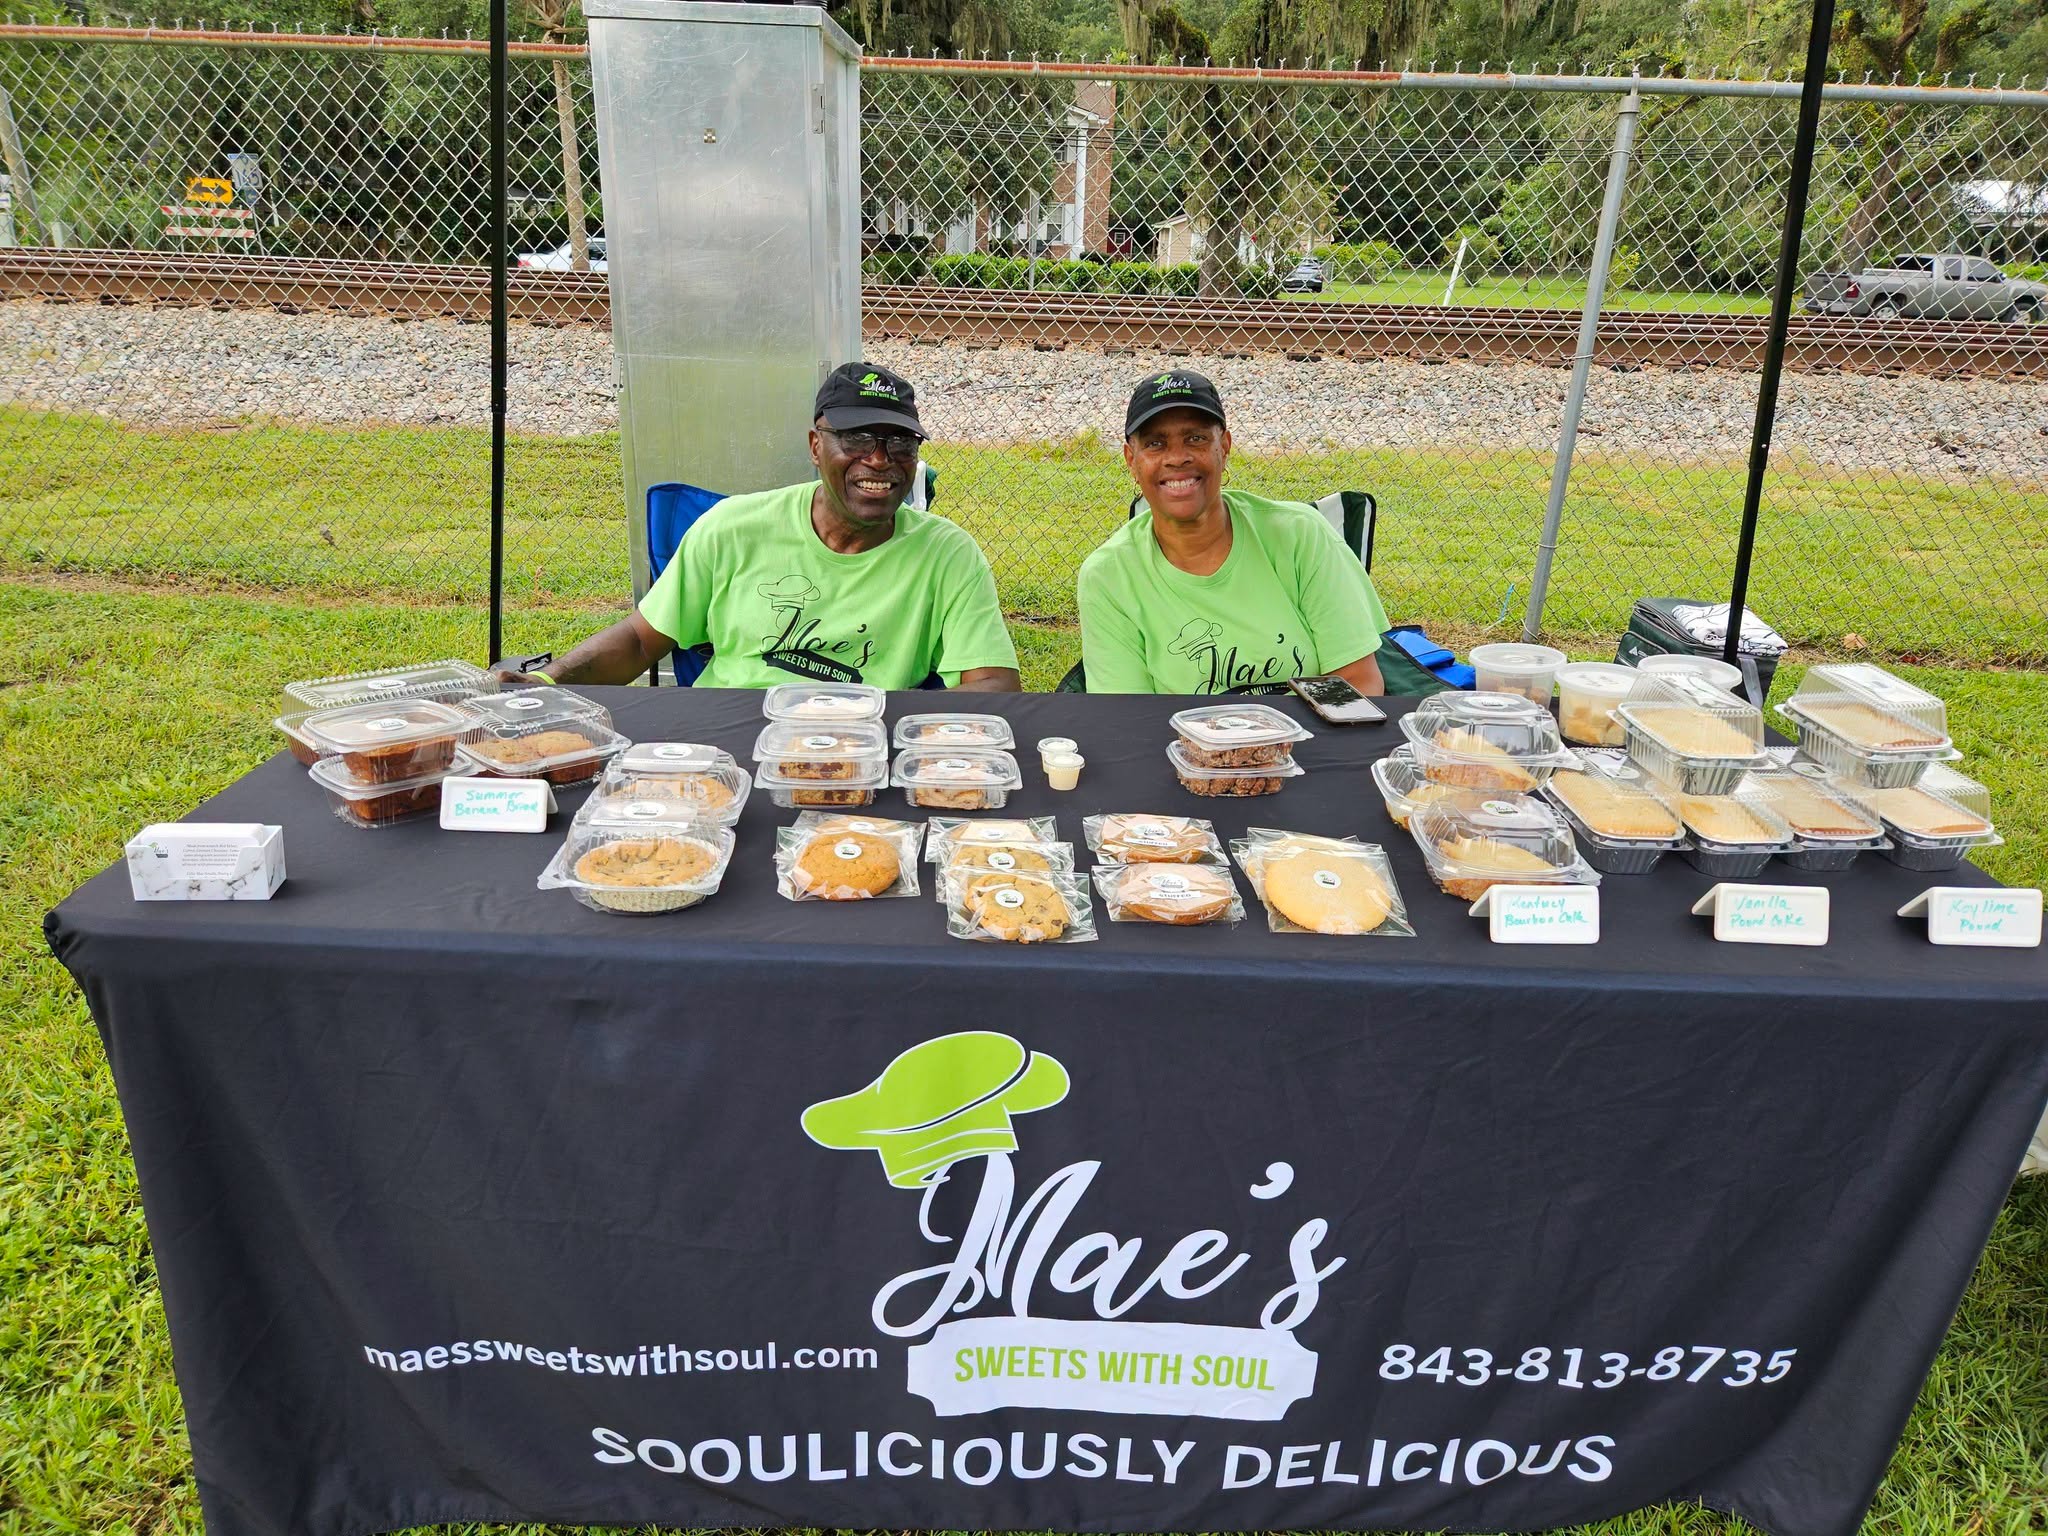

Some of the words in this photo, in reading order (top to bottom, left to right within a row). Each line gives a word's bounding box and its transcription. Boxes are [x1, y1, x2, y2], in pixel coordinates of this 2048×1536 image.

[760, 607, 876, 669] Mae's
[772, 652, 808, 670] SWEETS
[808, 660, 832, 677] WITH
[831, 668, 853, 685] SOUL
[1195, 633, 1306, 695] Mae's
[466, 789, 523, 801] Summer
[1730, 913, 1766, 928] Pound
[1732, 895, 1792, 911] Vanilla
[871, 1153, 1347, 1338] Mae's
[363, 1335, 879, 1378] maessweetswithsoul.com
[954, 1345, 1088, 1382] SWEETS
[1098, 1350, 1183, 1385] WITH
[1191, 1354, 1275, 1391] SOUL
[1378, 1344, 1798, 1389] 843-813-8735
[592, 1427, 1197, 1487] SOOULICIOUSLY
[1222, 1435, 1616, 1490] DELICIOUS
